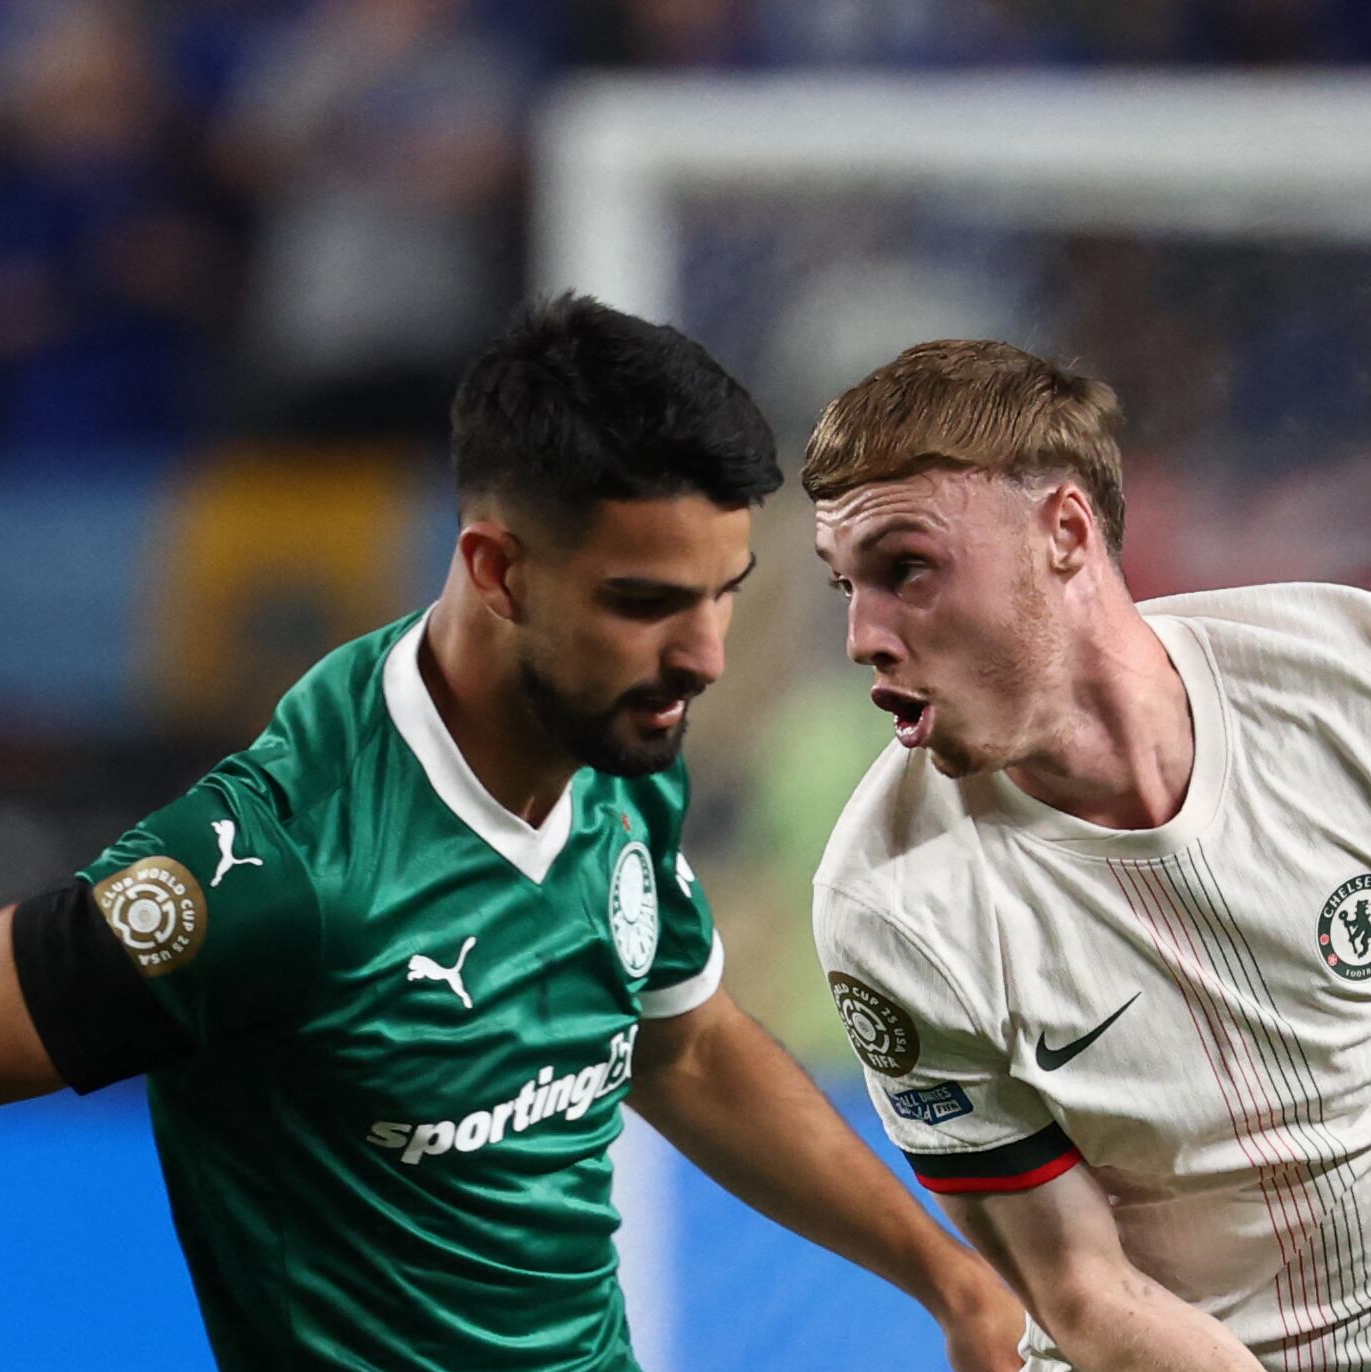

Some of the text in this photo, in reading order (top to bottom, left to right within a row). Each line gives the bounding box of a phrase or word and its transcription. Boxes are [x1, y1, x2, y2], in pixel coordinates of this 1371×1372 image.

[101, 877, 134, 908] CLUB
[137, 867, 186, 895] WORLD
[180, 898, 195, 932] CUP
[137, 949, 172, 966] USA
[851, 987, 879, 1006] CUP
[881, 1007, 899, 1024] 25
[894, 1028, 907, 1053] USA
[867, 1053, 901, 1069] FIFA
